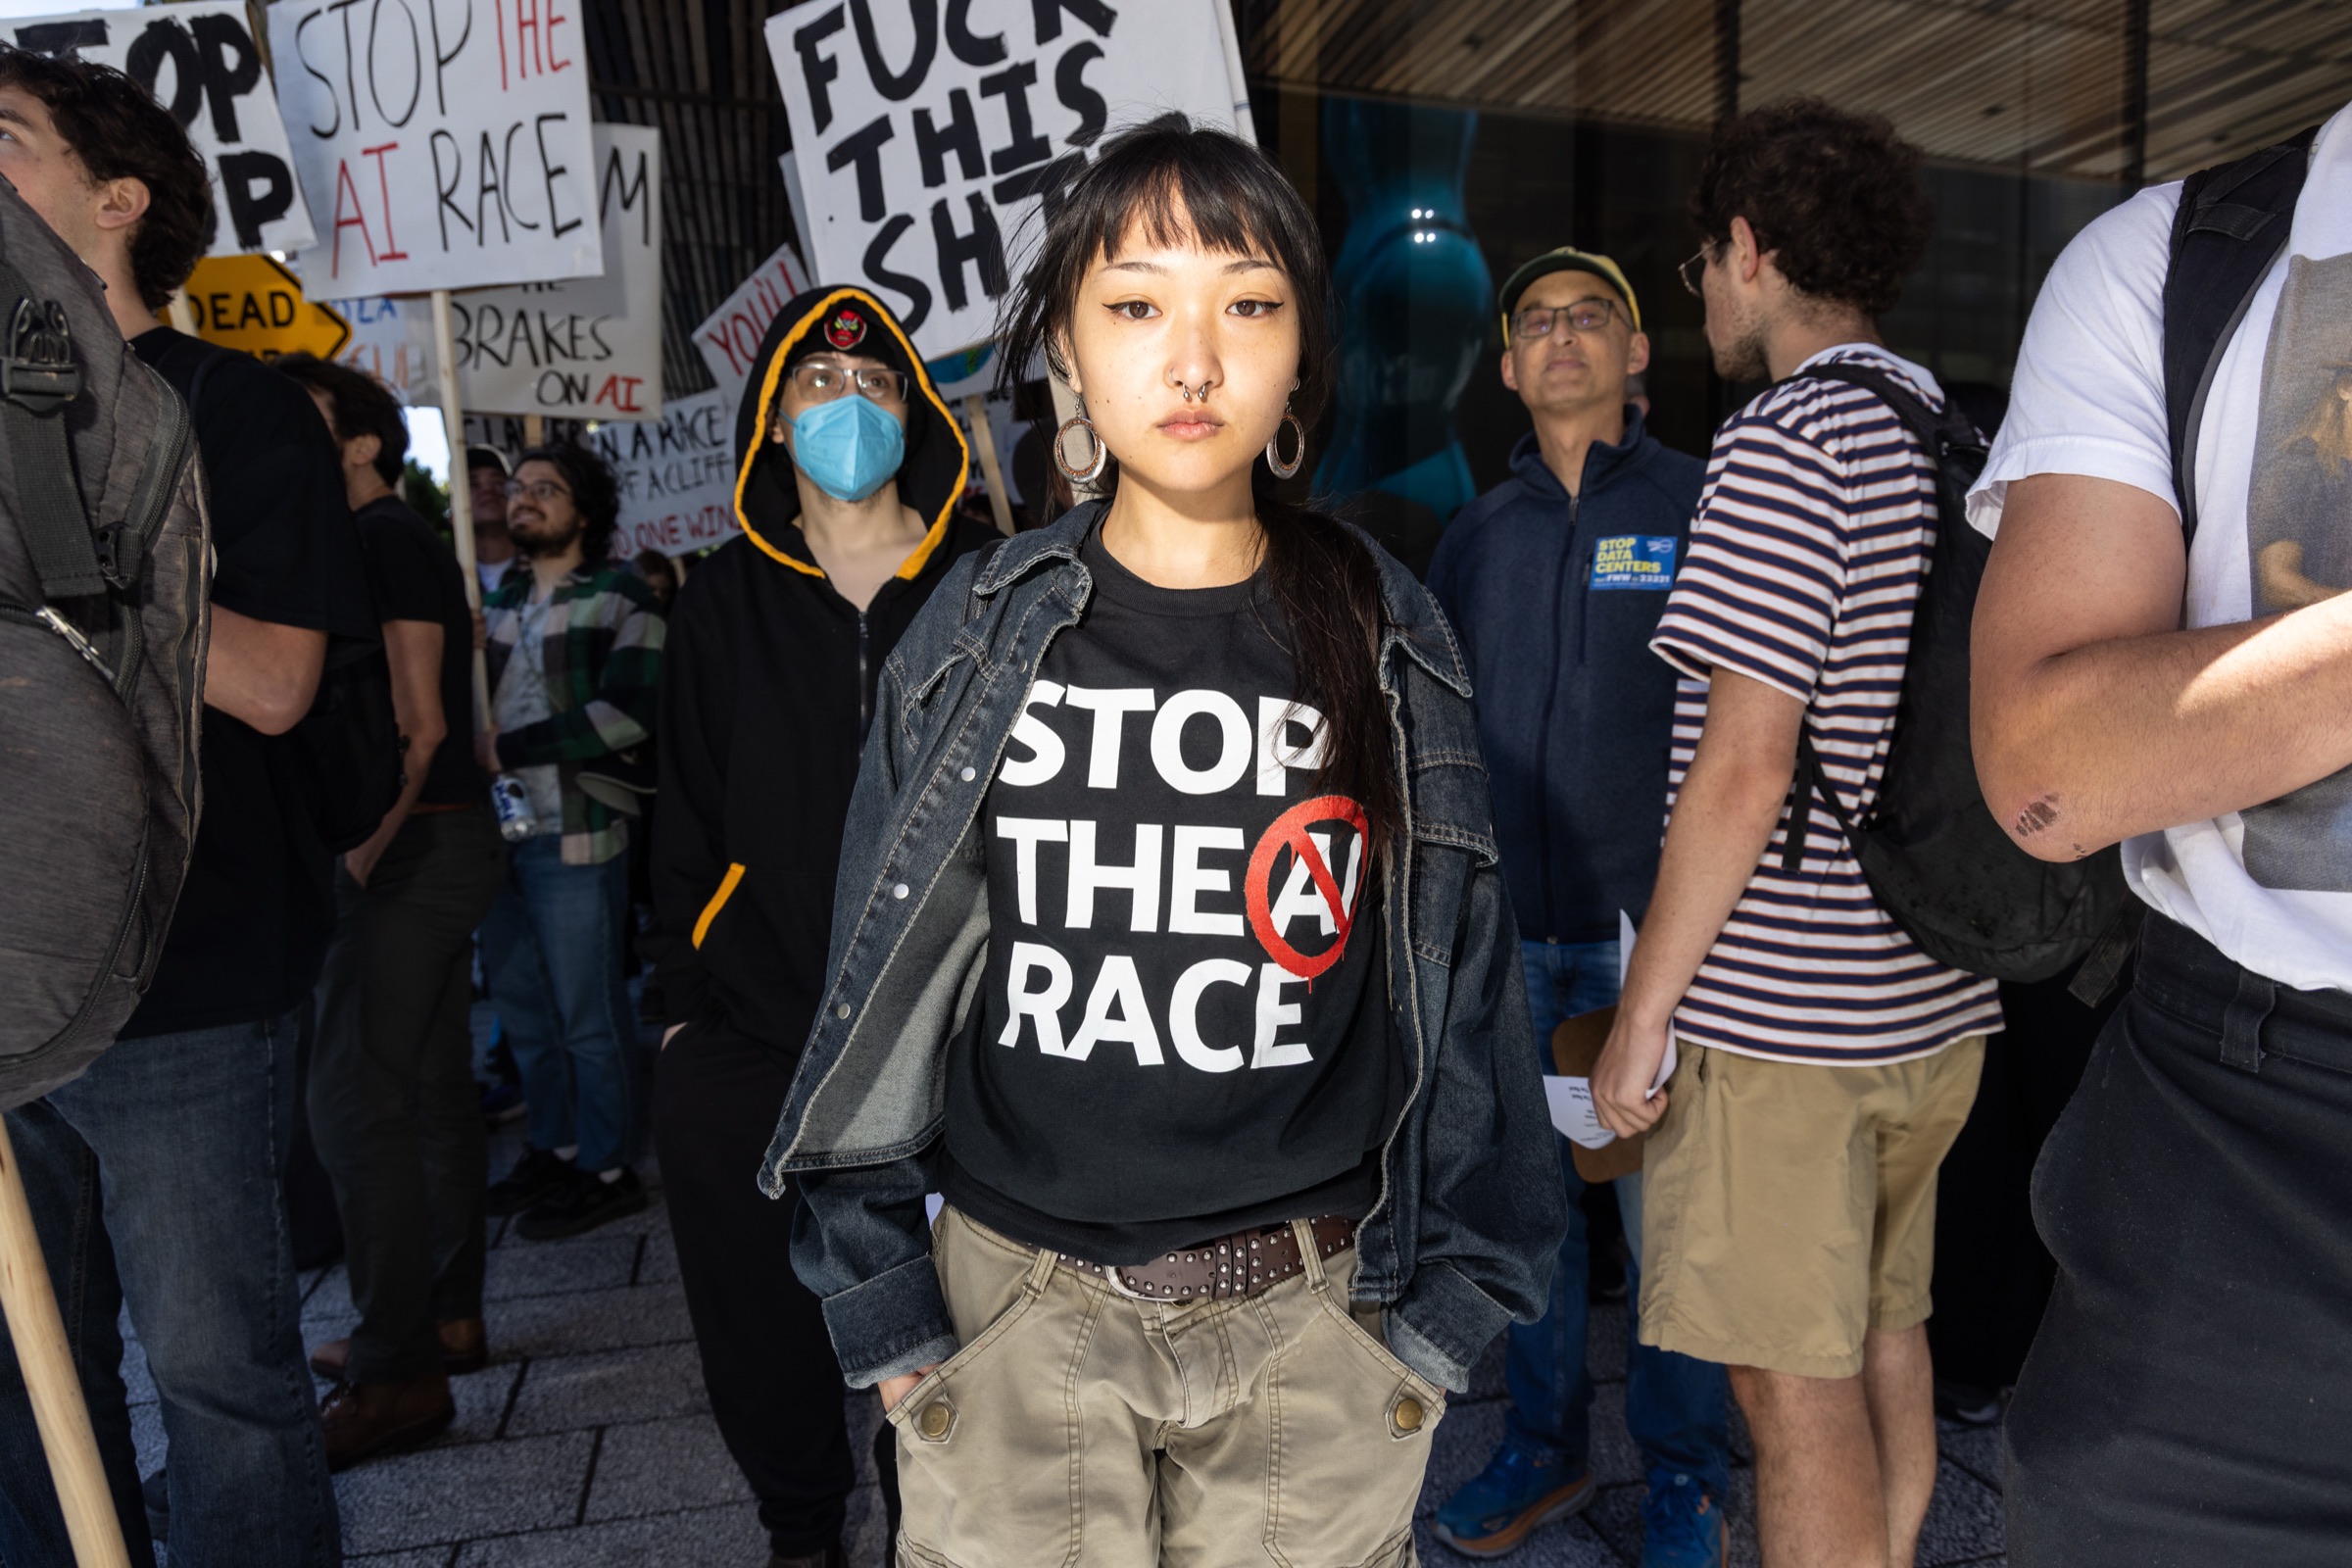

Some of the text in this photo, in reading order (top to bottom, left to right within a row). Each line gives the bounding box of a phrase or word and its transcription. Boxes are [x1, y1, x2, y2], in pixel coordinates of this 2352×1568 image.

[297, 0, 472, 139] STOP
[827, 40, 1107, 222] THIS
[331, 113, 583, 280] AI RACE
[452, 302, 613, 371] BRAKES
[536, 368, 645, 413] ON AI
[659, 405, 727, 459] RACE
[684, 502, 744, 538] WIN
[1599, 538, 1637, 551] STOP
[1595, 561, 1661, 573] CENTERS
[1597, 550, 1634, 562] DATA
[998, 679, 1338, 797] STOP
[996, 815, 1246, 937] THE
[998, 940, 1314, 1073] RACE
